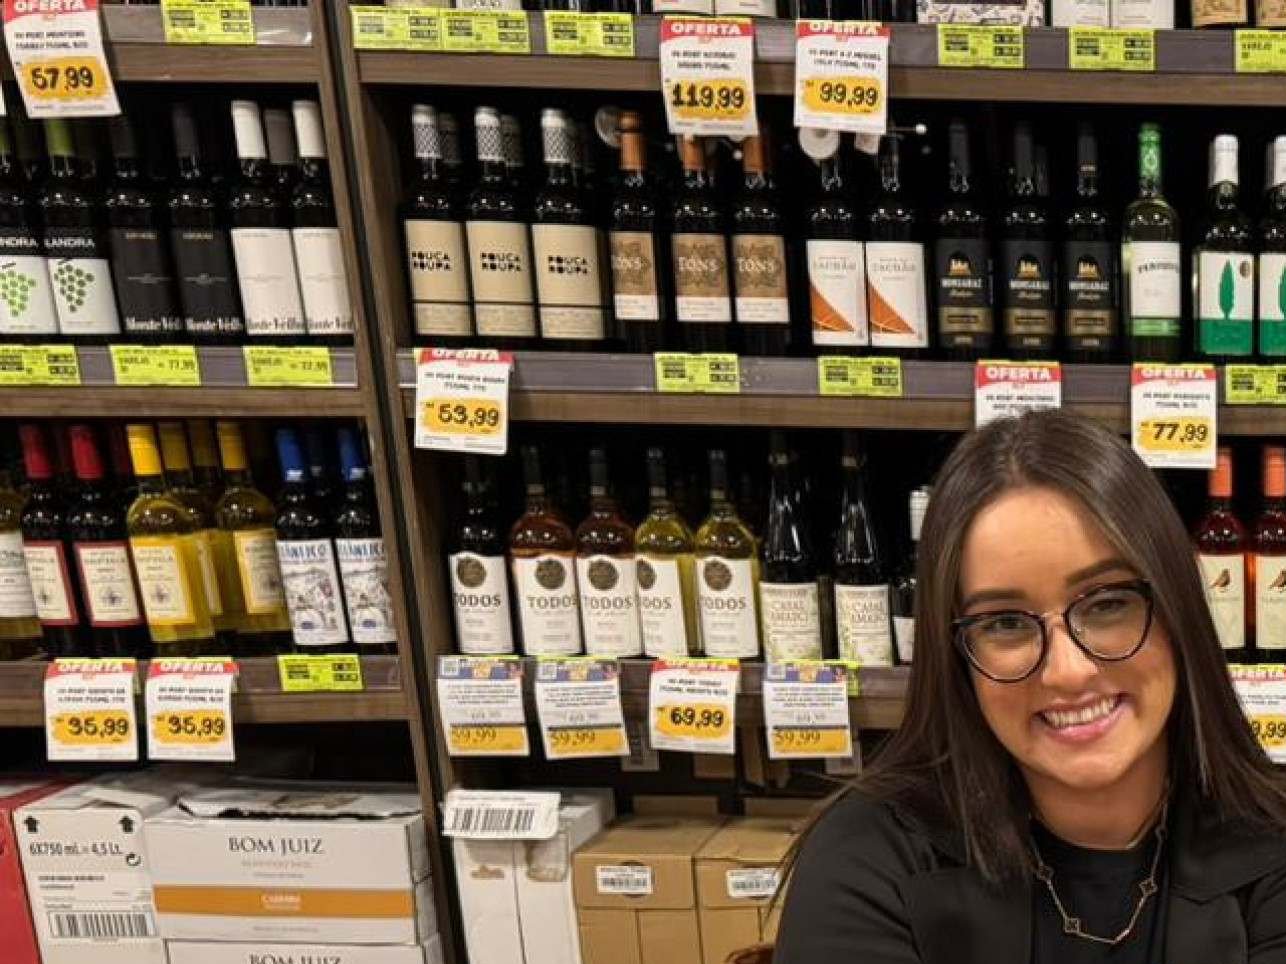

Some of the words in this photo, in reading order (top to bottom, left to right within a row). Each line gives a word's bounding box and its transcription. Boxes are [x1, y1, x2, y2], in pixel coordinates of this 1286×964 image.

[670, 22, 742, 36] OFERTA
[810, 21, 879, 35] OFERTA
[671, 84, 745, 110] 119,99
[818, 81, 879, 107] 99,99
[985, 367, 1051, 381] OFERTA
[1142, 368, 1206, 380] OFERTA
[1152, 422, 1208, 443] 77,99
[67, 716, 129, 738] 35,99
[167, 714, 225, 737] 35,99
[228, 837, 275, 853] BOM
[280, 838, 325, 856] JUIZ
